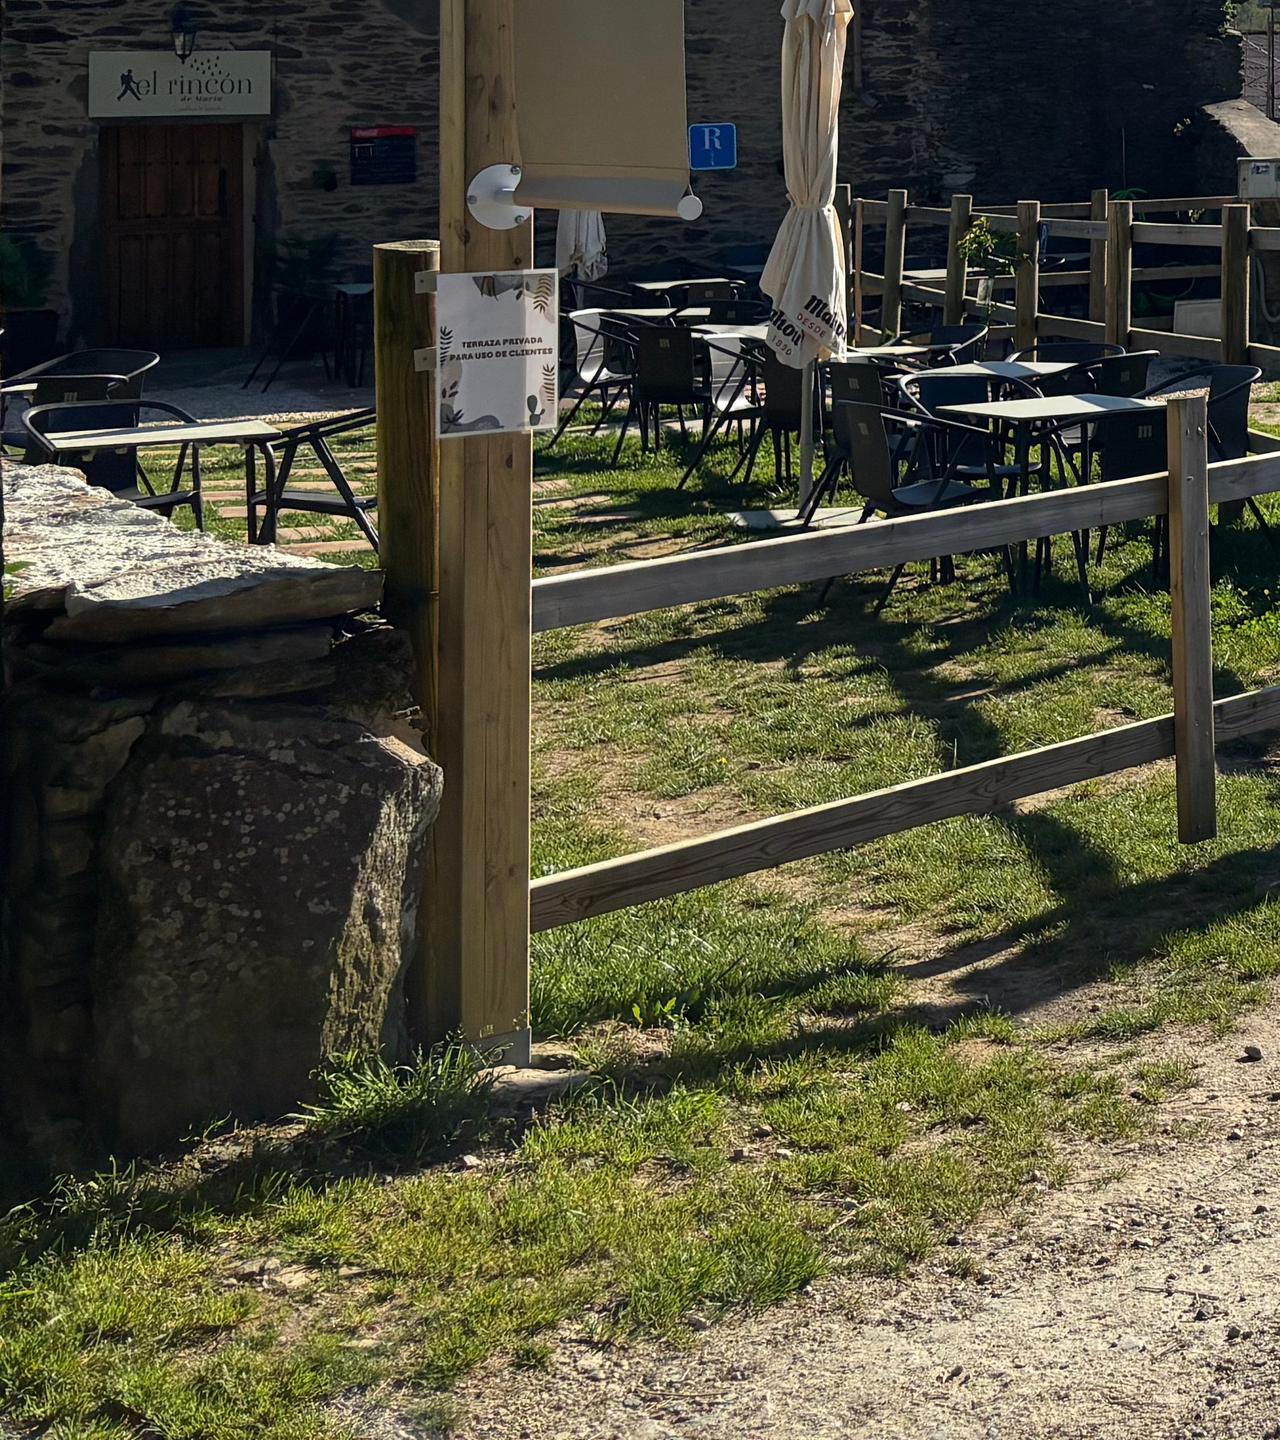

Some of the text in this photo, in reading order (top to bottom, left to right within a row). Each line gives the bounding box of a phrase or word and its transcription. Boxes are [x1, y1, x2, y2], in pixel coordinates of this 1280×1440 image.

[137, 71, 252, 96] el rincón
[701, 127, 723, 150] R
[797, 313, 826, 338] DESDE
[449, 347, 553, 361] PARA USO DE CLIENTES
[462, 337, 543, 349] TERRAZA PRIVADA
